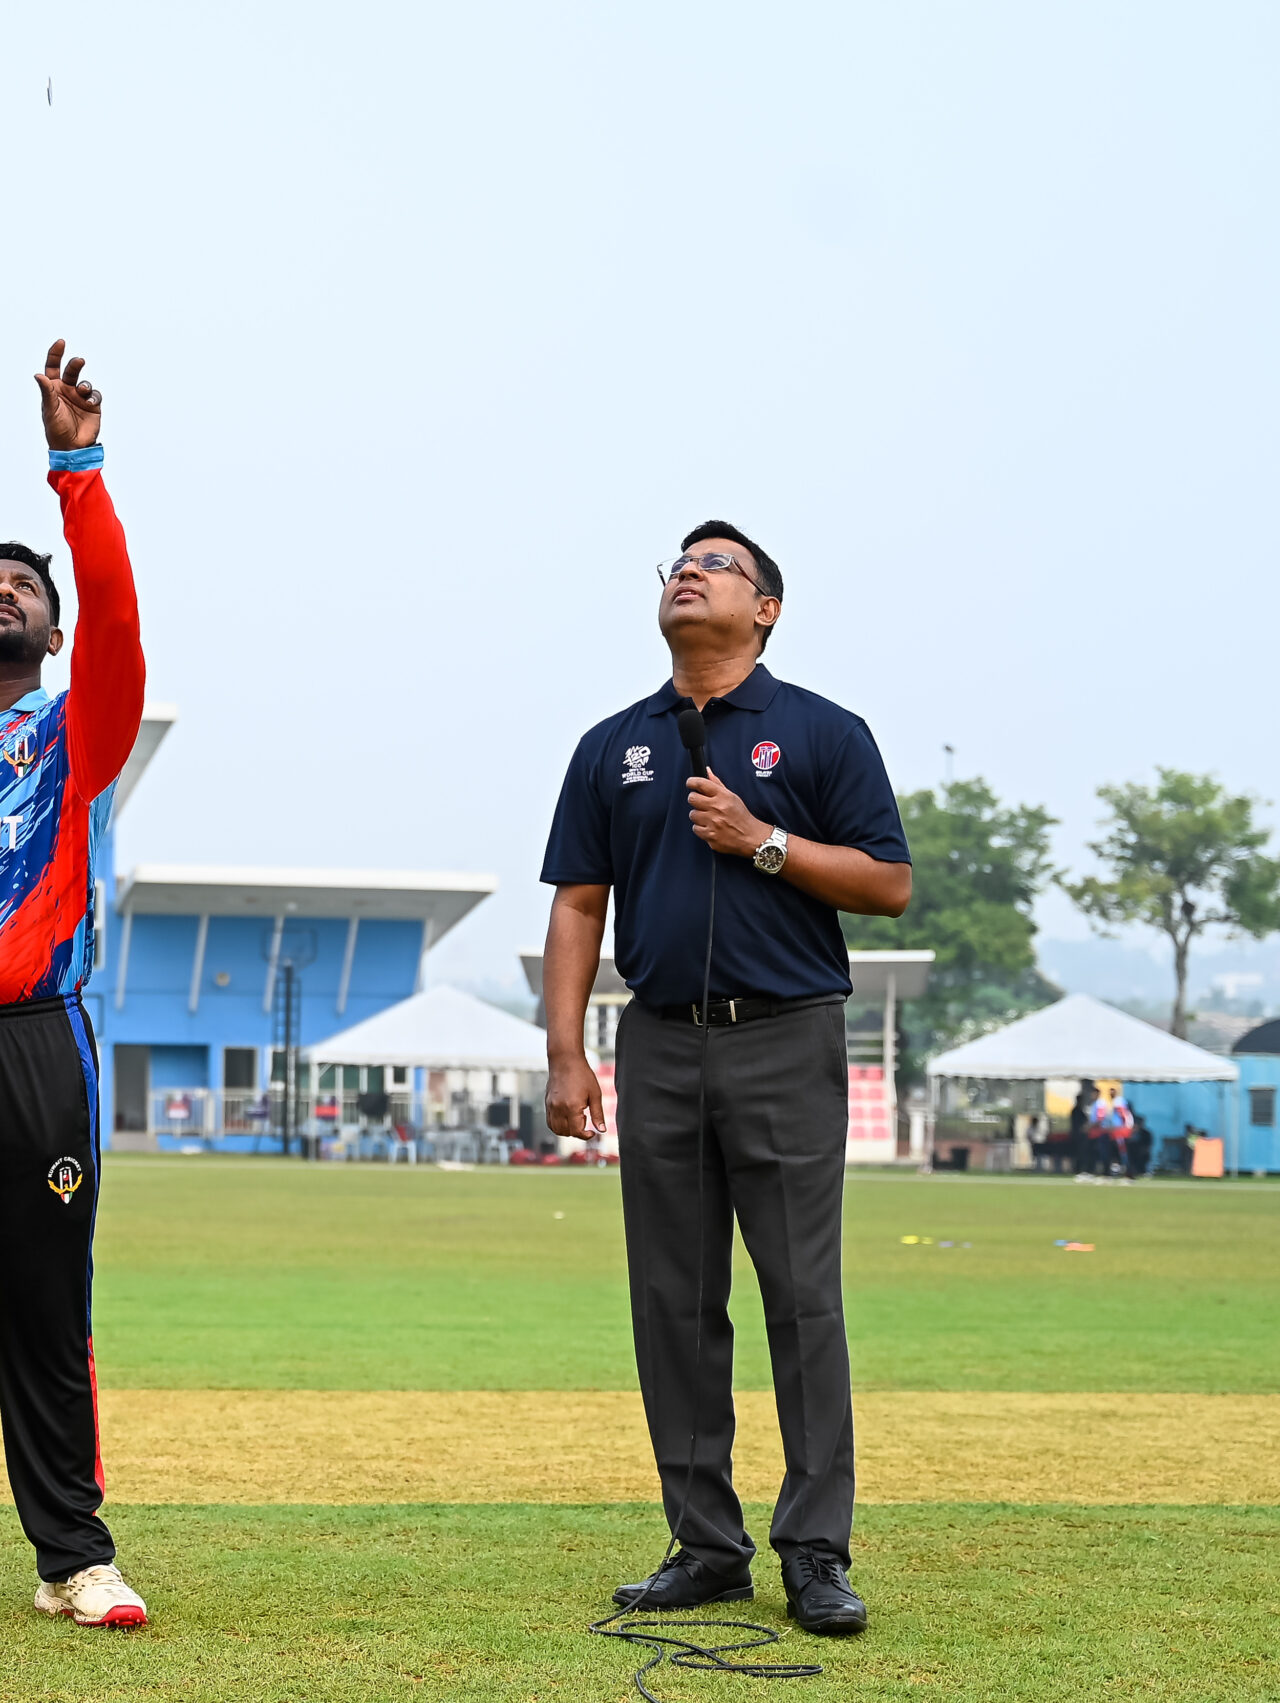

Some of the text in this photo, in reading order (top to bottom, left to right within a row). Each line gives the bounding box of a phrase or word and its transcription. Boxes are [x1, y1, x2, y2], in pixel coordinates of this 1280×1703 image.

[621, 771, 641, 779] WORLD
[47, 1156, 82, 1178] KUWAIT CRICKET
